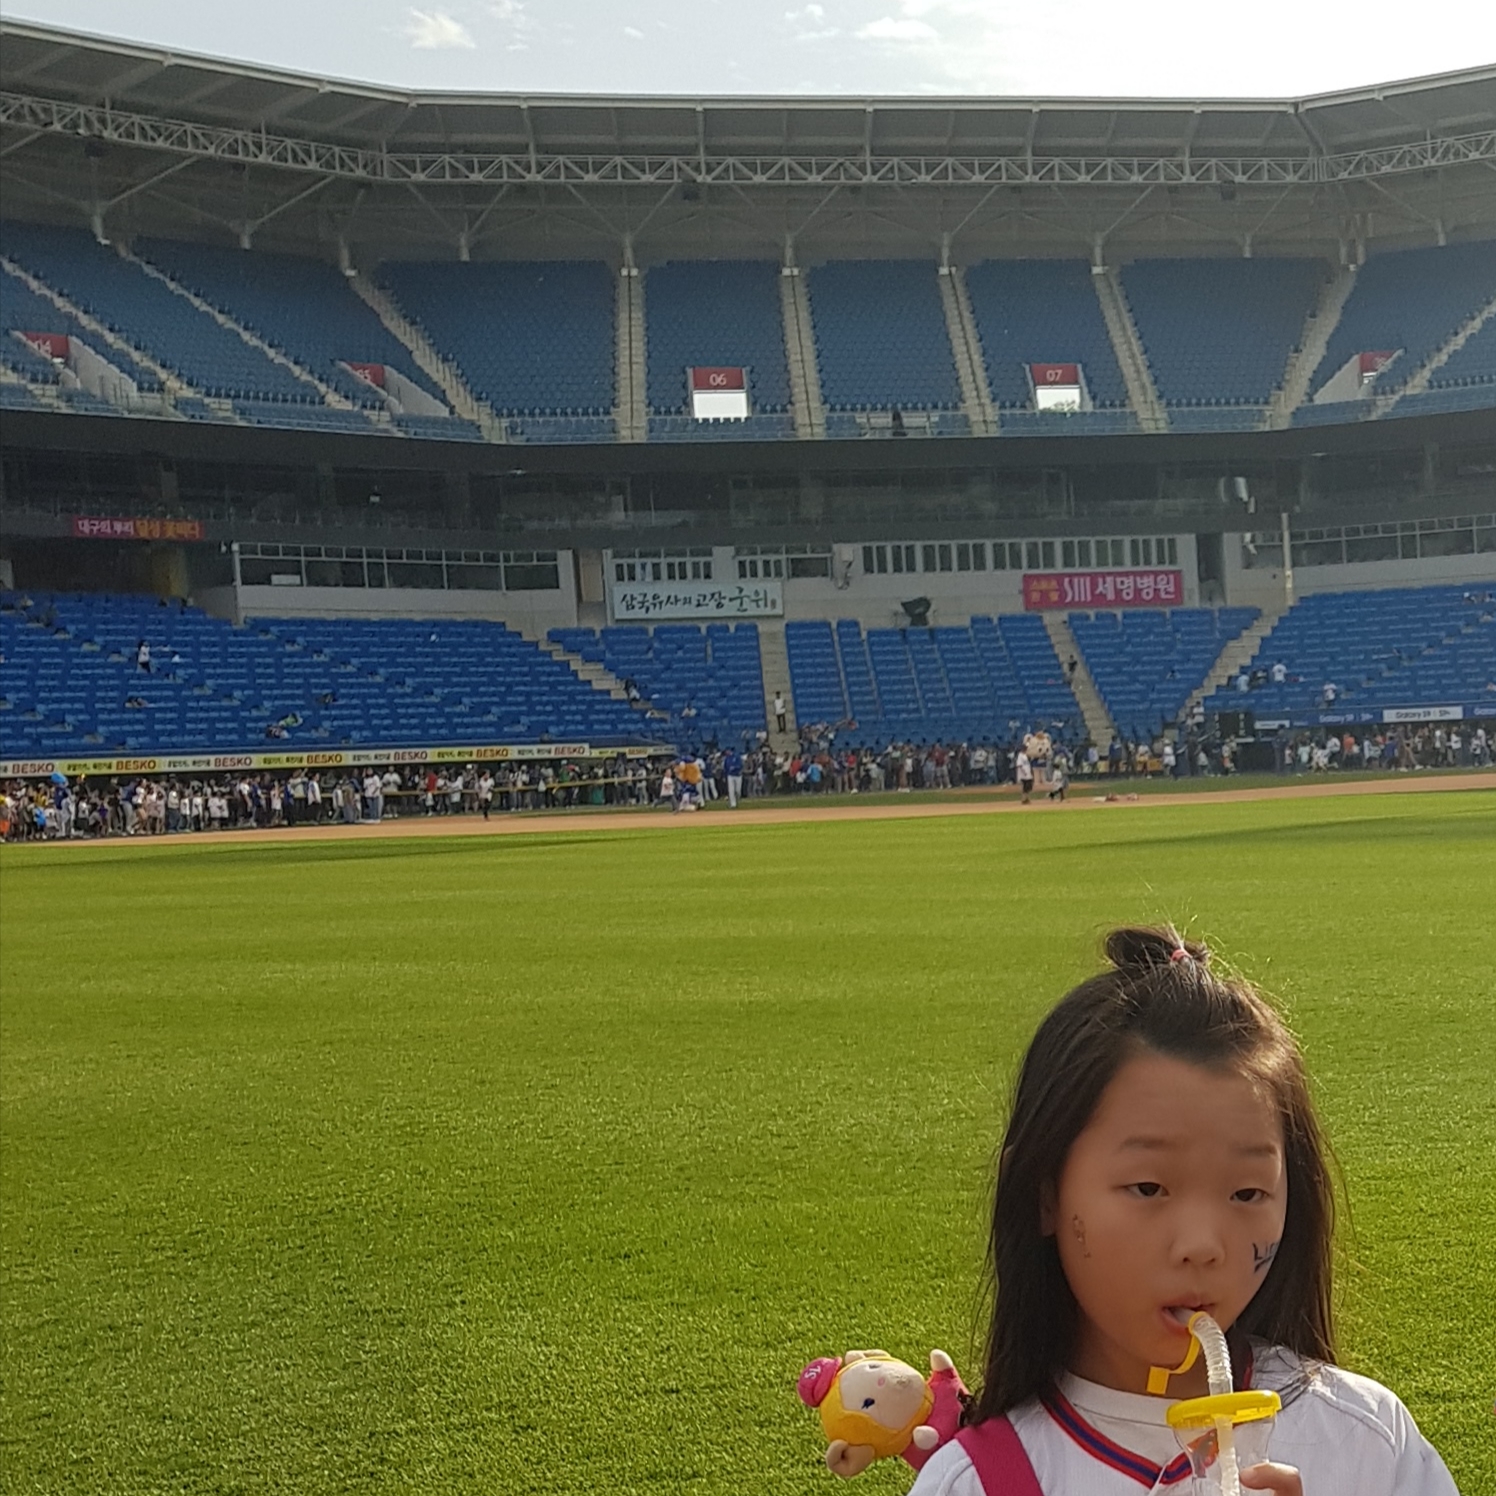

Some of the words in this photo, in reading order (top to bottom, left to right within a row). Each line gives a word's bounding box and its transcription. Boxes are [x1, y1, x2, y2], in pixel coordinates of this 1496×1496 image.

[709, 373, 727, 386] 06
[1046, 369, 1063, 382] 07
[1095, 574, 1176, 601] 세명병원
[475, 748, 509, 759] BESKO
[554, 745, 585, 756] BESKO
[214, 757, 252, 767] BESKO
[306, 753, 343, 764] BESKO
[393, 751, 428, 762] BESKO
[12, 763, 55, 775] BESKO
[115, 759, 157, 771] BESKO
